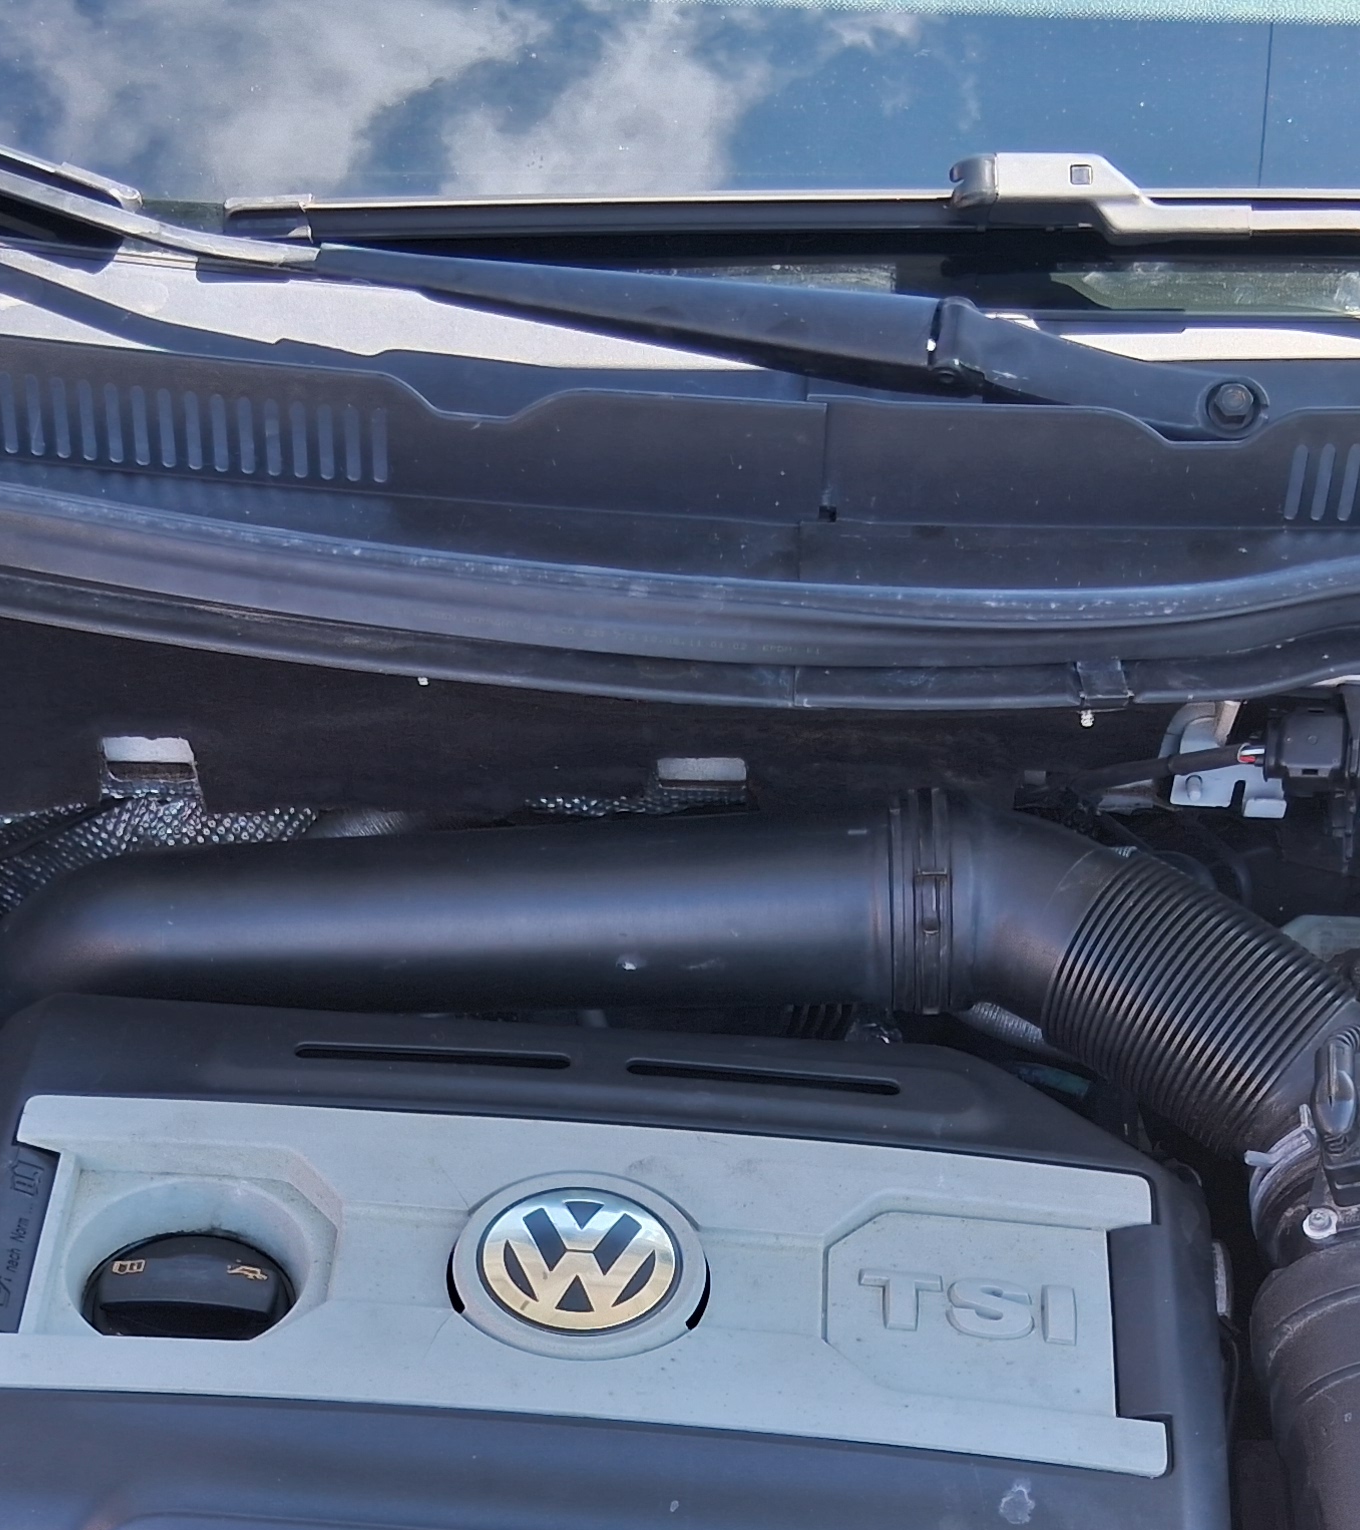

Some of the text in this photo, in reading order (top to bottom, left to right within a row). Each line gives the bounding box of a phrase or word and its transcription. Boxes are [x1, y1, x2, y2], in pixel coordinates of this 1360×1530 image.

[6, 1217, 30, 1274] nach Norm
[857, 1267, 1078, 1347] TSI
